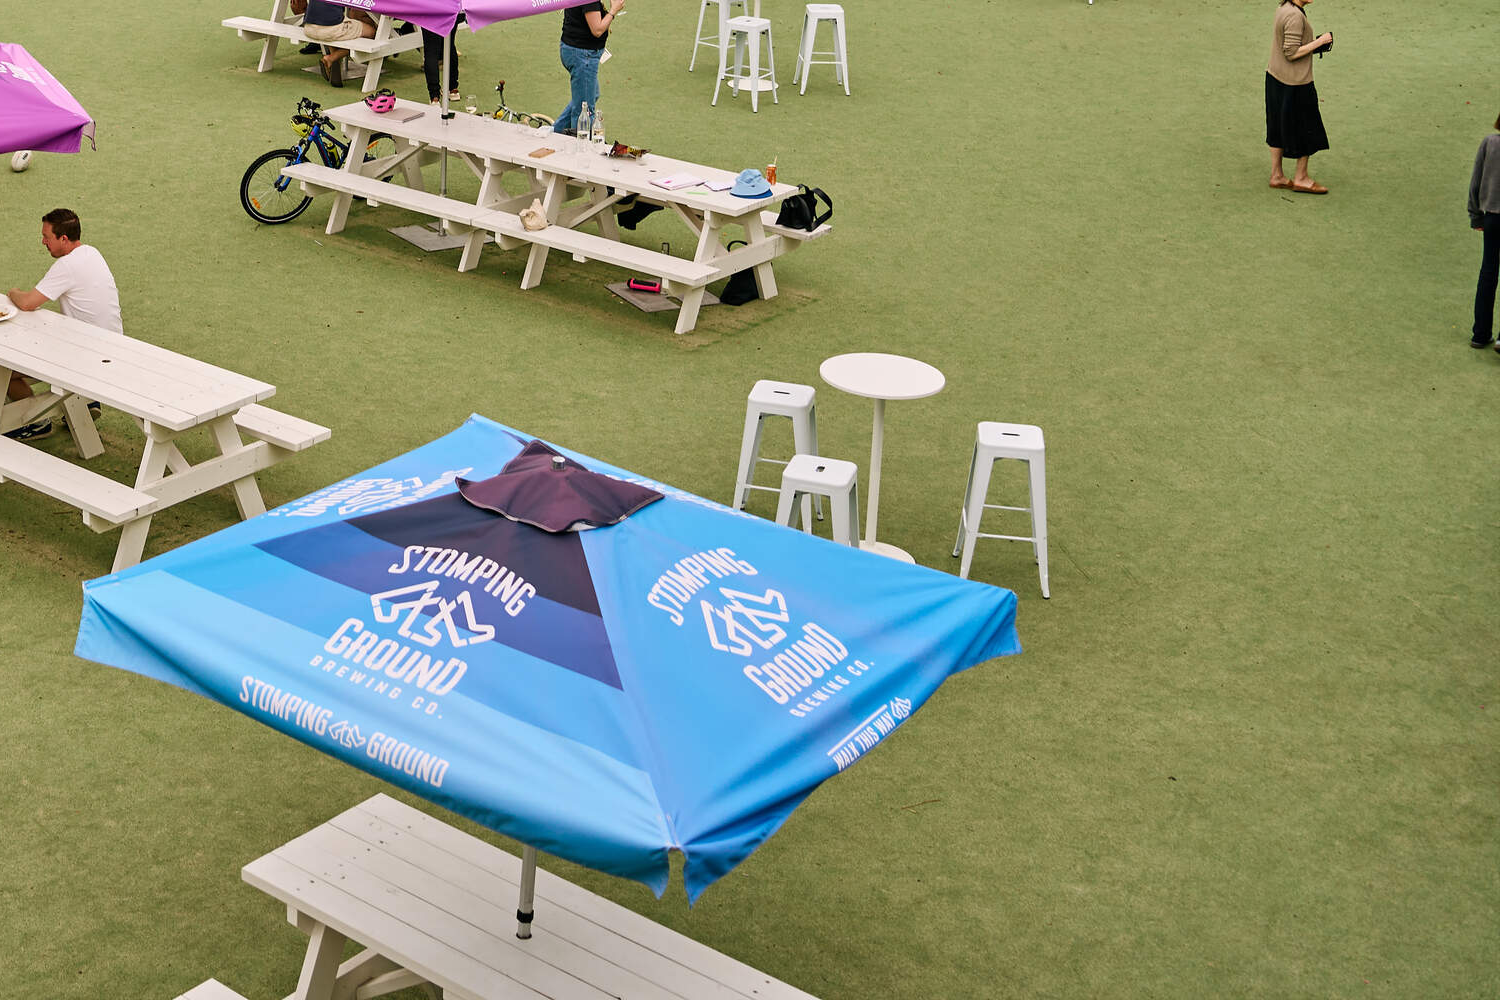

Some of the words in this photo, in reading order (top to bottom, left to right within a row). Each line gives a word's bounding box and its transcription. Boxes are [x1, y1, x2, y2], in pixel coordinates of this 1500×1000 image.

[387, 545, 537, 617] STOMPING
[647, 547, 758, 627] STOMPING
[309, 654, 402, 699] BREWING
[411, 696, 443, 720] CO.
[323, 617, 468, 696] GROUND
[743, 622, 849, 705] GROUND
[789, 674, 850, 718] BREWING
[846, 659, 875, 677] CO.
[239, 675, 333, 737] STOMPING
[366, 731, 449, 788] GROUND
[832, 741, 860, 772] WALK
[856, 725, 880, 754] THIS
[873, 711, 898, 737] WAY
